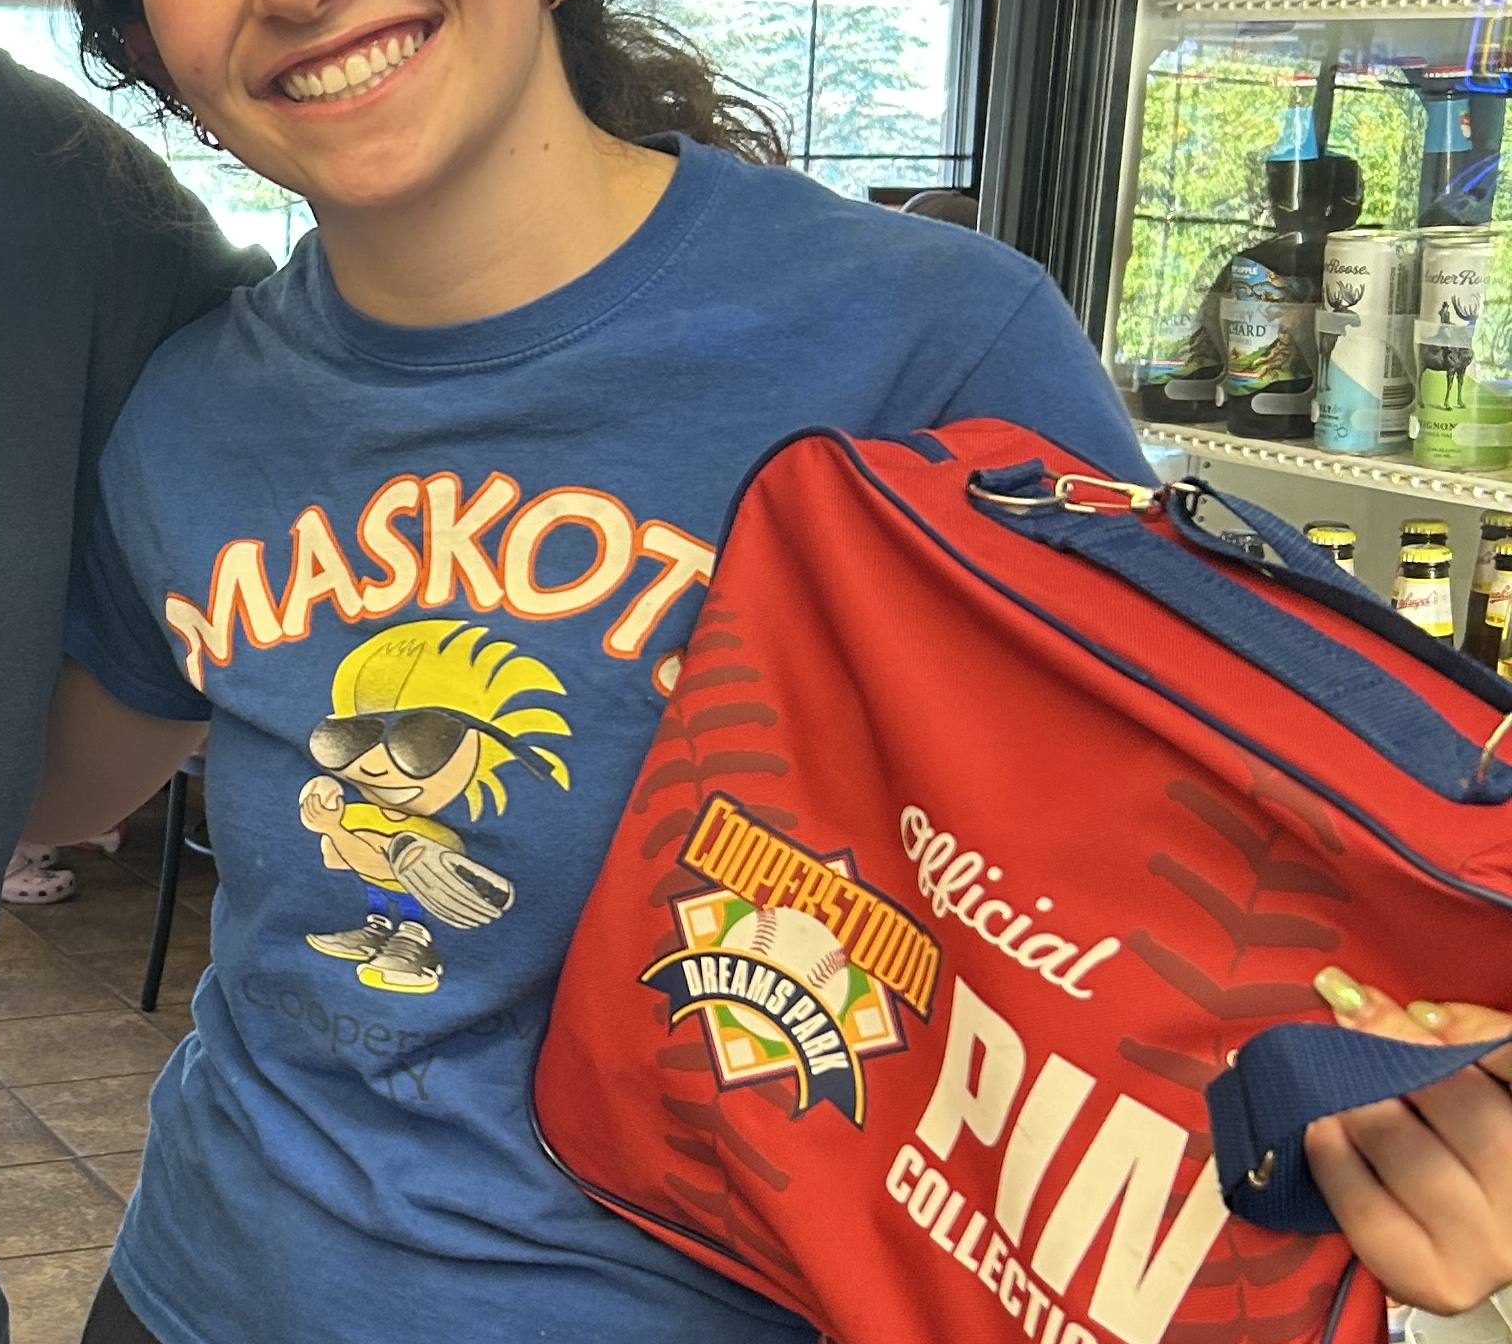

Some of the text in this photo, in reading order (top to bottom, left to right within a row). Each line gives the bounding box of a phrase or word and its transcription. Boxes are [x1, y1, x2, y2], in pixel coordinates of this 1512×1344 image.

[165, 471, 717, 698] MASKOT
[682, 956, 849, 1075] DREAMS PARK
[685, 798, 940, 1016] COOPERSTOWN
